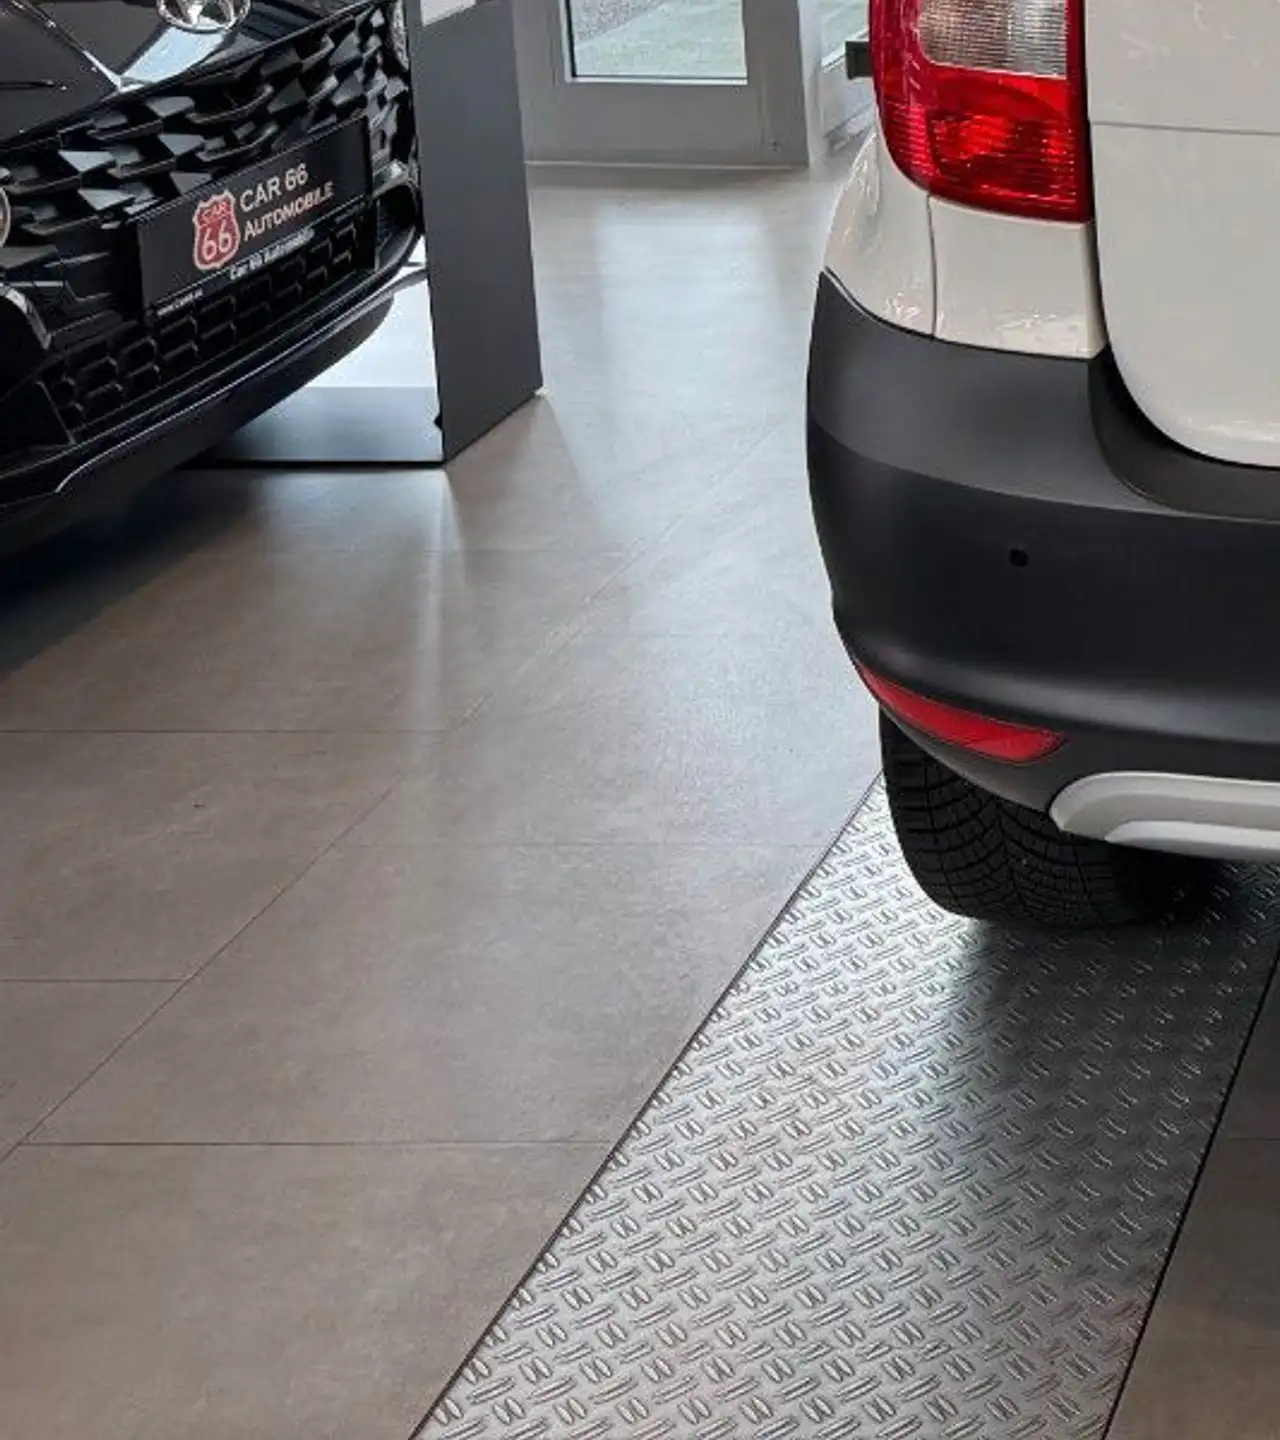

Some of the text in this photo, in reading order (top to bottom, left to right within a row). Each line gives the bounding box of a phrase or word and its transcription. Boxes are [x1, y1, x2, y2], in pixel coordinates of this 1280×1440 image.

[238, 162, 309, 213] CAR 66
[201, 200, 230, 226] CAR
[201, 224, 233, 262] 66
